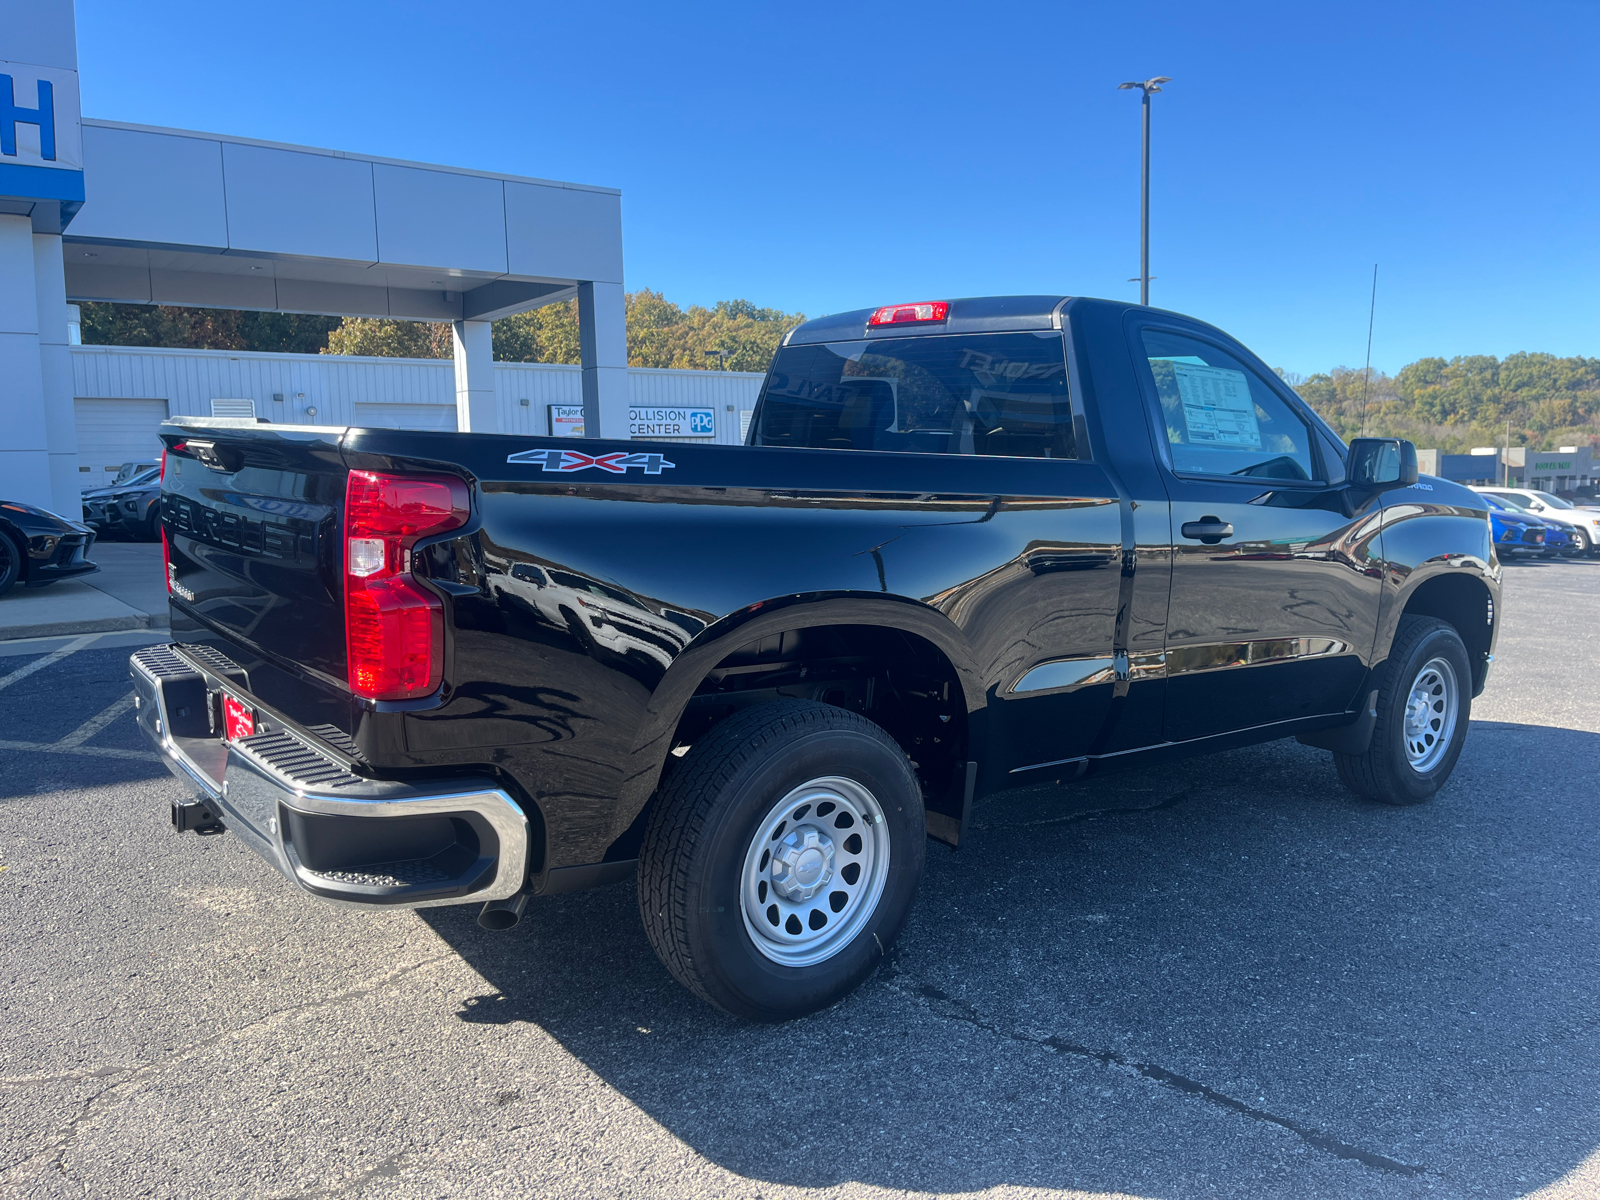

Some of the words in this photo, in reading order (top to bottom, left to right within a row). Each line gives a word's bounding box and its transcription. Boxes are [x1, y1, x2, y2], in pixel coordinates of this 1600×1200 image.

[555, 407, 579, 417] Taylor
[691, 413, 712, 432] PPG
[630, 423, 681, 434] CENTER
